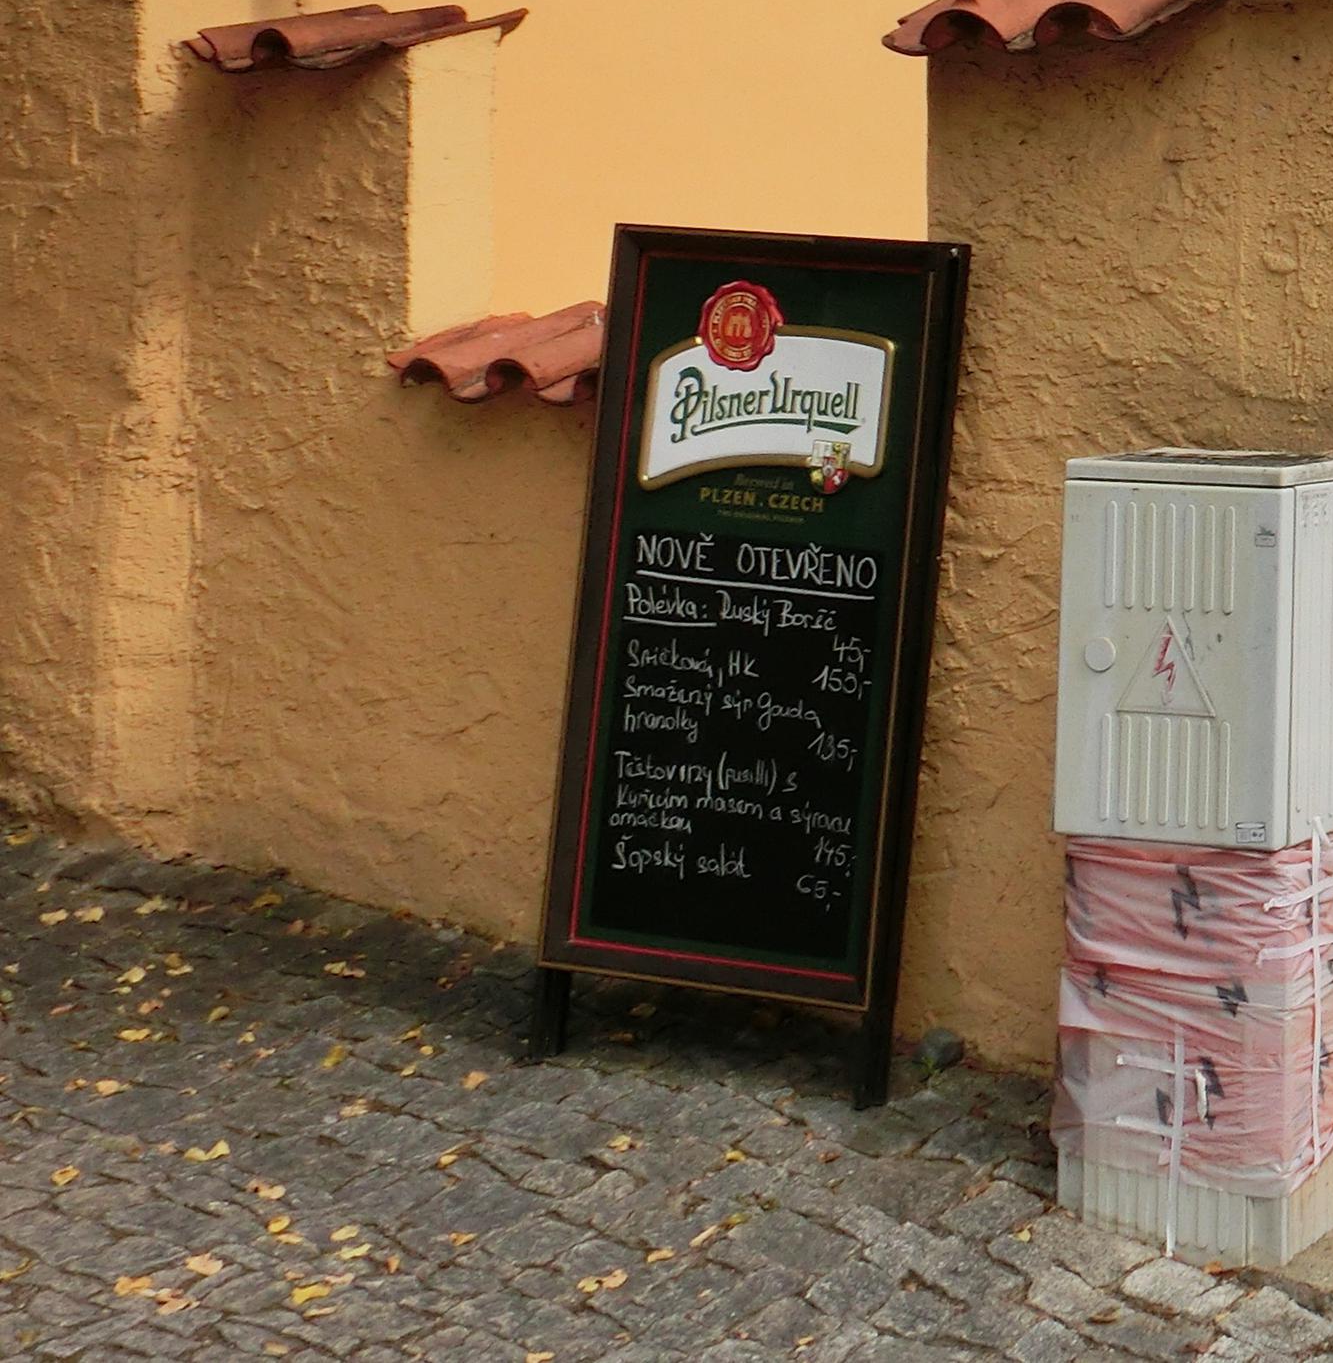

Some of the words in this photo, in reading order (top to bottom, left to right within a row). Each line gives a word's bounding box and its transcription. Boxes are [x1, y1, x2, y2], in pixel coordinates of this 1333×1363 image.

[669, 365, 771, 444] Pilsner
[769, 369, 861, 434] Urquell
[767, 493, 824, 513] CZECH
[636, 532, 715, 572] NOVĚ
[736, 542, 878, 589] OTEVŘENO
[715, 589, 773, 637] Ruský
[769, 806, 783, 822] a
[696, 842, 753, 878] salát
